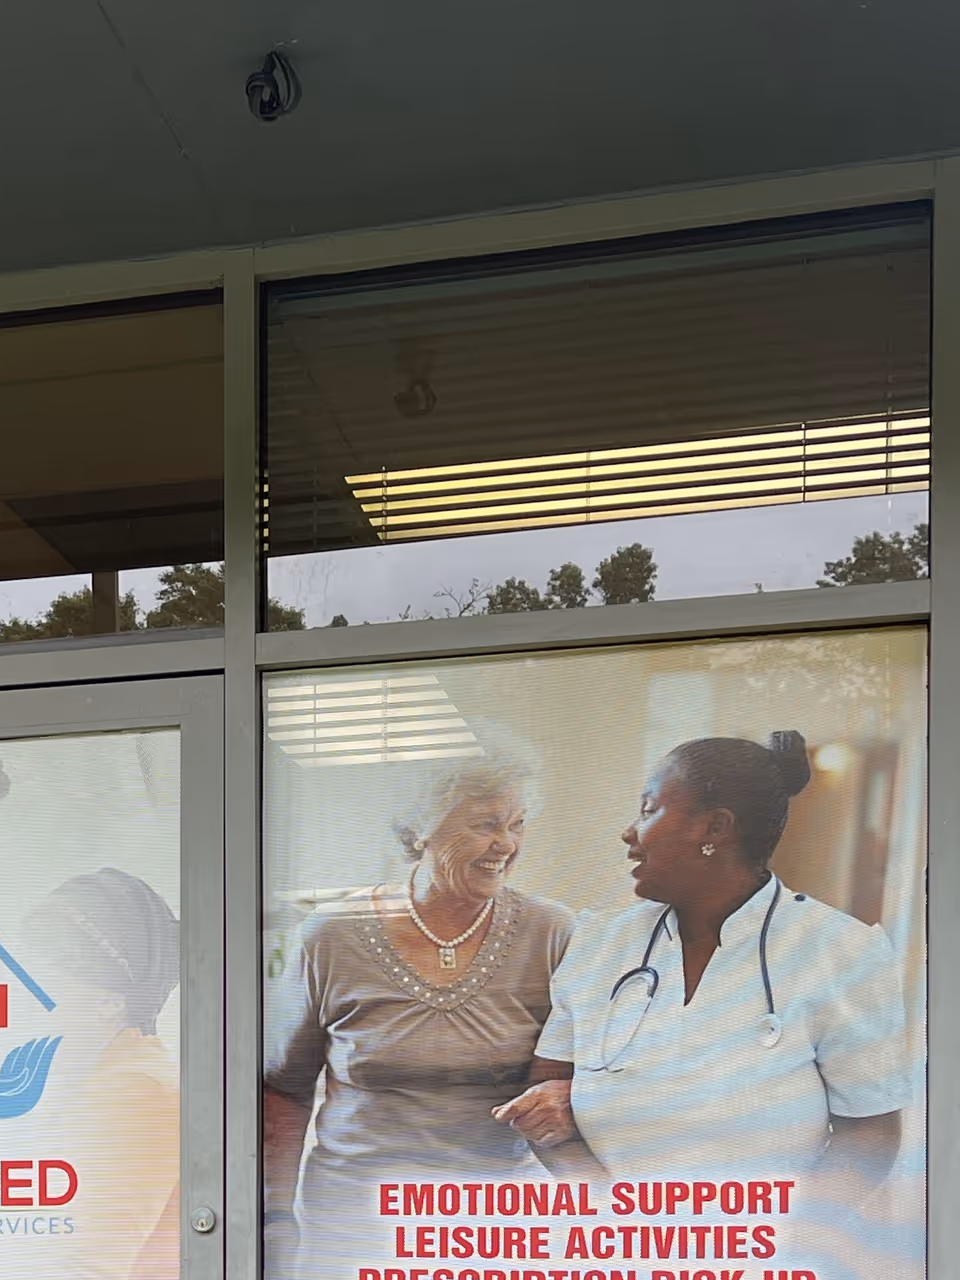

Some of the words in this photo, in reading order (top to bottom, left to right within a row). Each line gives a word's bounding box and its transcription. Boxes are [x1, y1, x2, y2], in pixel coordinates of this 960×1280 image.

[379, 1183, 598, 1217] EMOTIONAL
[611, 1180, 796, 1216] SUPPORT
[395, 1226, 550, 1260] LEISURE
[564, 1225, 776, 1260] ACTIVITIES
